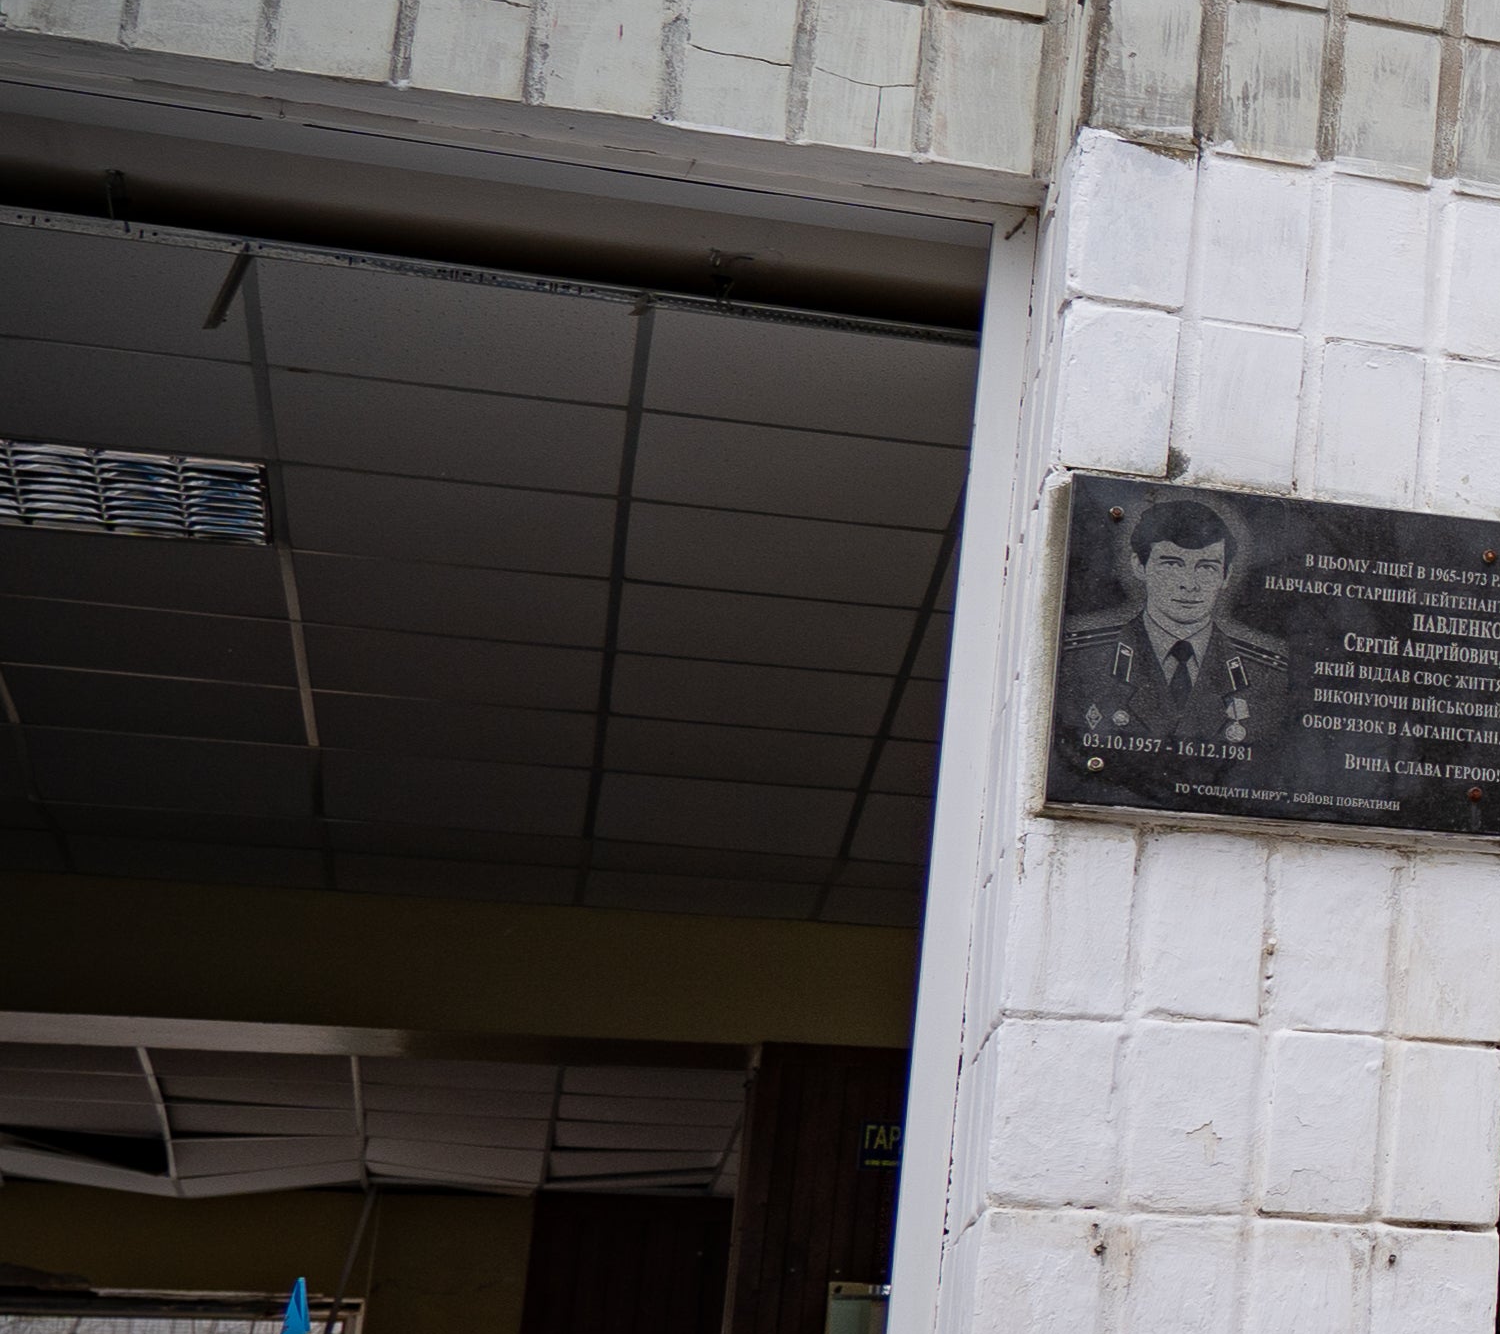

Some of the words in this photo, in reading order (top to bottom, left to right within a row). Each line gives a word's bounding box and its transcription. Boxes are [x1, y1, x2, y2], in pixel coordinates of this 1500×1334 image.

[1306, 554, 1314, 567] В
[1318, 555, 1370, 574] ЦЬОМУ
[1373, 561, 1413, 579] ЛІЦЕЇ
[1417, 568, 1426, 579] В
[1430, 569, 1488, 586] 1965-1973
[1265, 576, 1342, 596] НАВЧАВСЯ
[1346, 584, 1417, 605] СТАРШИЙ
[1343, 633, 1399, 656] СЕРГІЙ
[1314, 661, 1355, 679] ЯКИЙ
[1359, 665, 1410, 683] ВІДДАВ
[1413, 671, 1451, 687] СВОЄ
[1314, 688, 1408, 711] ВИКОНУЮЧИ
[1388, 722, 1397, 735] В
[1083, 733, 1161, 753] 03.10.1957
[1178, 741, 1252, 761] 16.12.1981
[1344, 753, 1391, 773] ВІЧНА
[1395, 760, 1442, 777] СЛАВА
[1445, 764, 1500, 783] ГЕРОЮ!
[1175, 782, 1190, 793] ГО
[1293, 790, 1333, 806] БОЙОВІ
[1336, 795, 1401, 811] ПОБРАТИМИ
